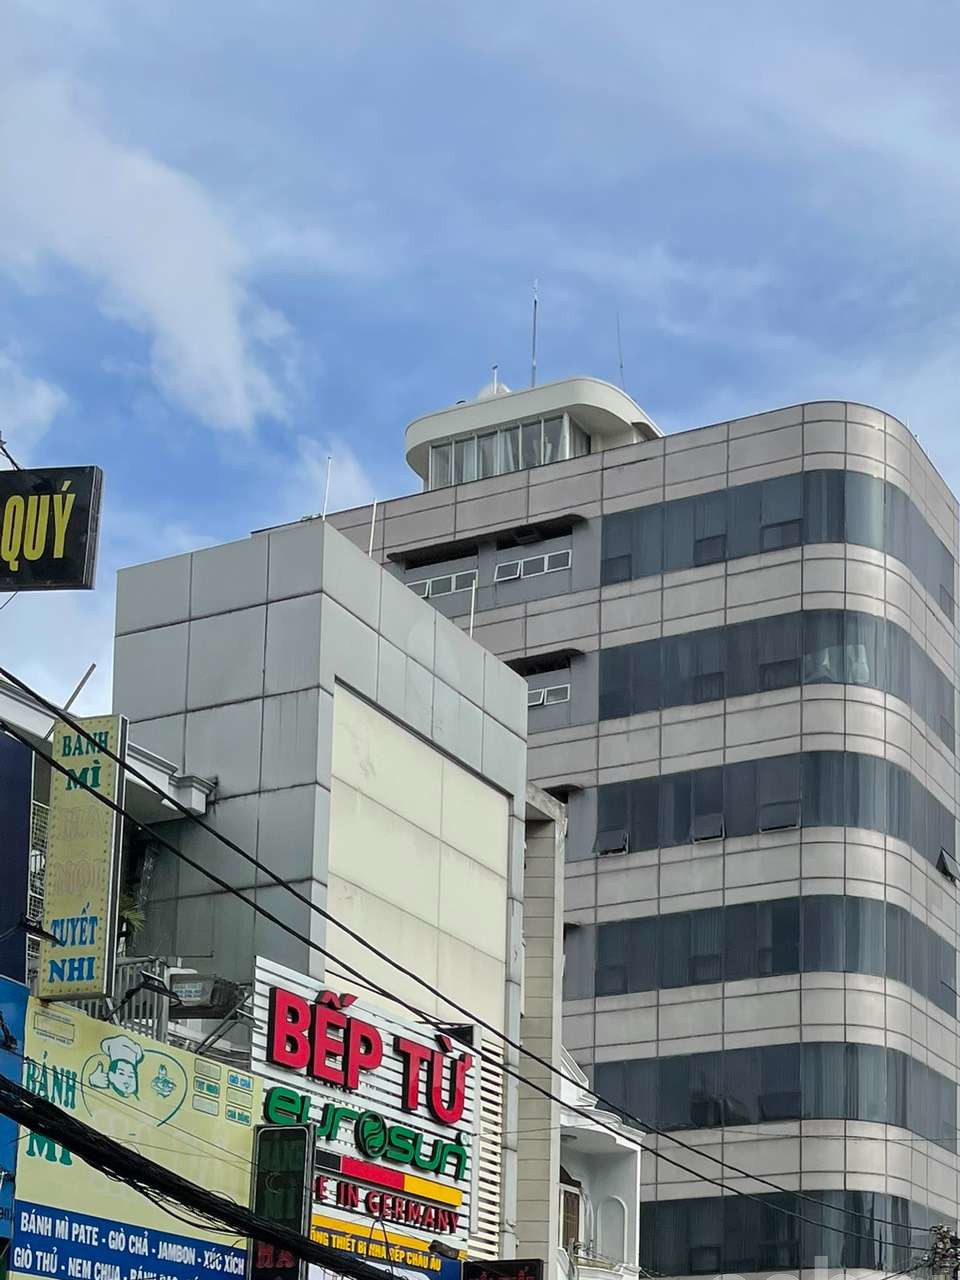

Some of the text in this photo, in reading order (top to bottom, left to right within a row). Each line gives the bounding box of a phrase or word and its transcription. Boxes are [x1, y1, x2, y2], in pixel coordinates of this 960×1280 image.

[1, 480, 77, 572] QUÝ
[65, 759, 101, 791] MÌ
[48, 956, 96, 983] NHI
[267, 988, 473, 1125] BẾP TỪ
[366, 1190, 459, 1233] GERMANY
[14, 1244, 32, 1269] GIÒ
[36, 1247, 58, 1274] THỦ
[68, 1257, 92, 1280] NEM
[20, 1209, 52, 1237] BÁNH
[55, 1216, 69, 1240] MÌ
[72, 1223, 99, 1246] PATE
[108, 1228, 126, 1252] GIÒ
[128, 1231, 149, 1256] CHẢ
[158, 1241, 196, 1265] JAMBON
[224, 1252, 245, 1275] XÍCH
